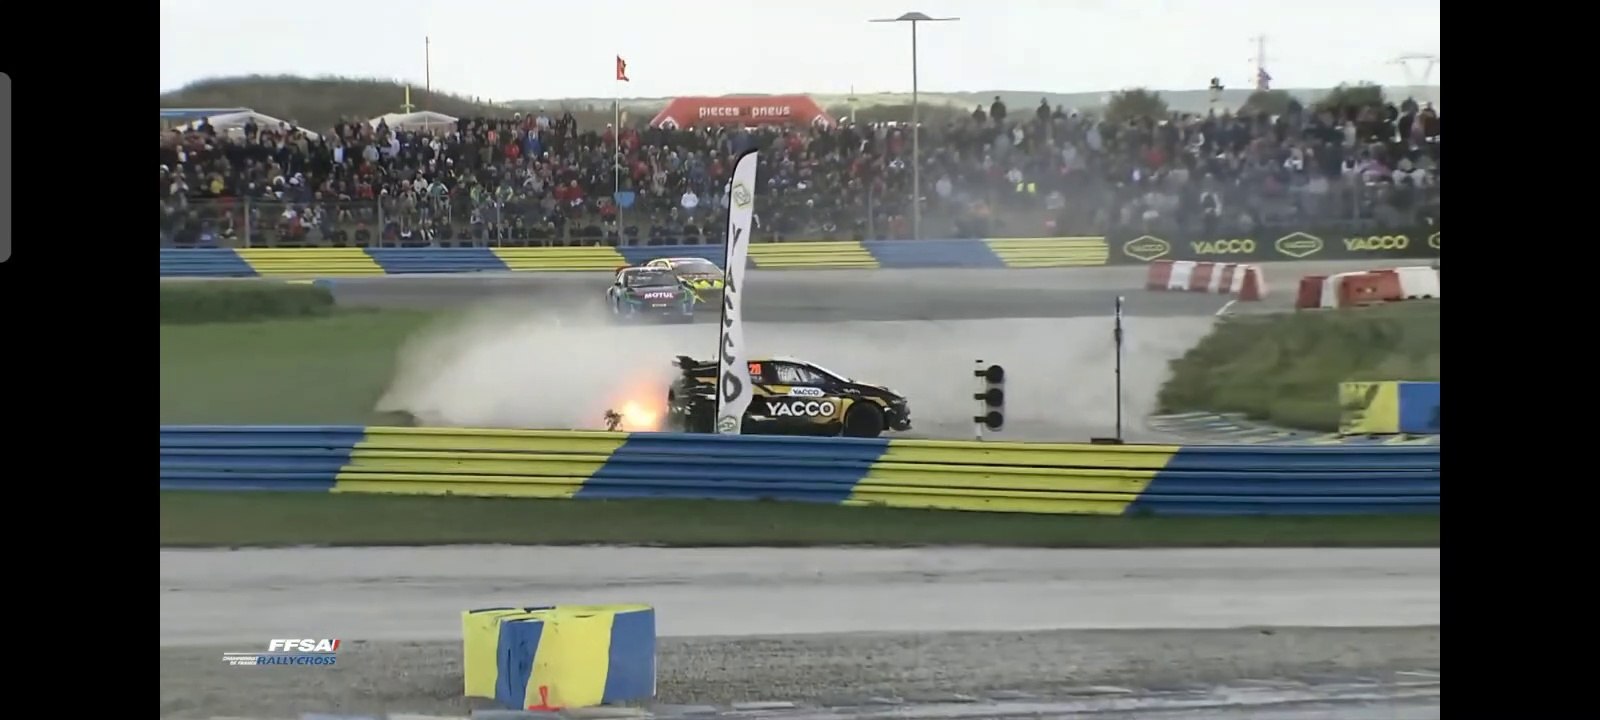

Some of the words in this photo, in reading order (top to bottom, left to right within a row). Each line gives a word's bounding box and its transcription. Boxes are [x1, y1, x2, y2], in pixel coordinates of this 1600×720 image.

[751, 105, 791, 118] pneus
[1190, 238, 1256, 254] YACCO
[1343, 234, 1409, 251] YACCO
[644, 292, 673, 300] MOTUL
[792, 388, 820, 396] YACCO
[766, 400, 835, 417] YACCO
